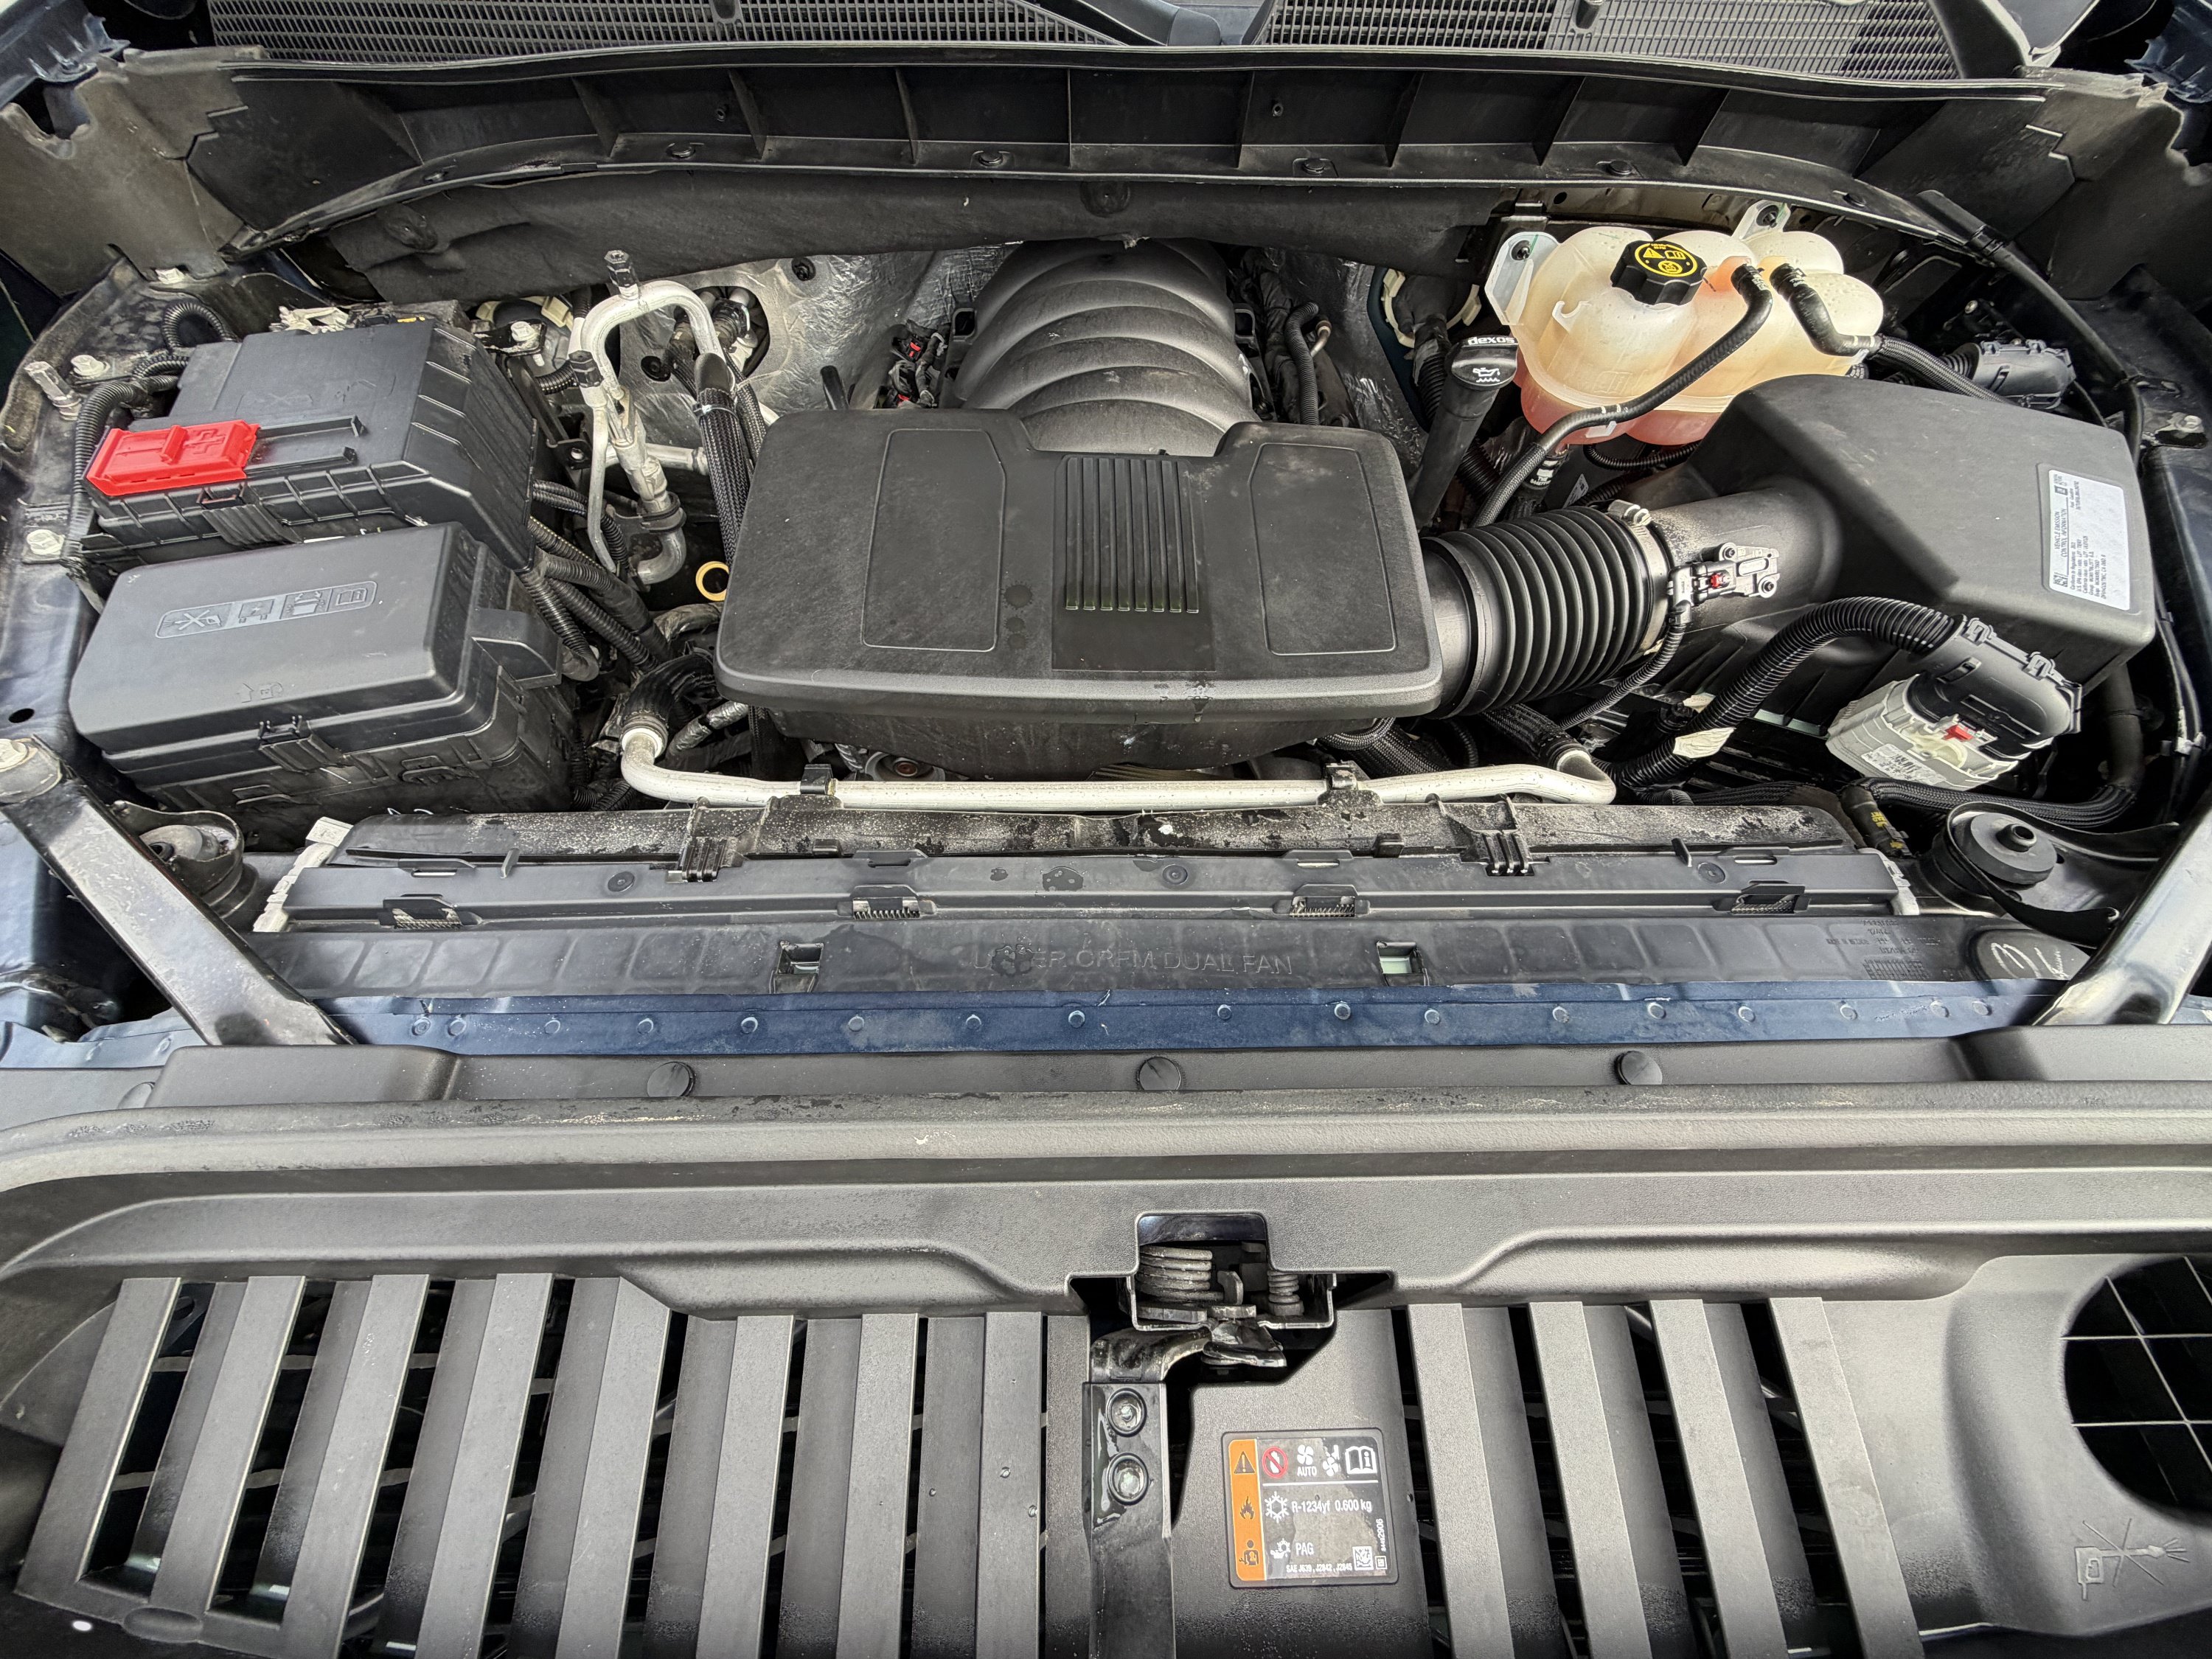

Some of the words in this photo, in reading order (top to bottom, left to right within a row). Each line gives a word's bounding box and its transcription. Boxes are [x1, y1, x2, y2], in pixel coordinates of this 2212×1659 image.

[1467, 336, 1515, 346] dexos
[1164, 952, 1235, 972] DUAL
[1242, 955, 1293, 975] FAN
[1297, 1466, 1318, 1477] AUTO
[1291, 1500, 1330, 1514] R-1234yf
[1335, 1499, 1359, 1512] 0.600
[1360, 1498, 1373, 1513] kg
[1295, 1542, 1315, 1556] PAG
[1285, 1564, 1298, 1573] SAE
